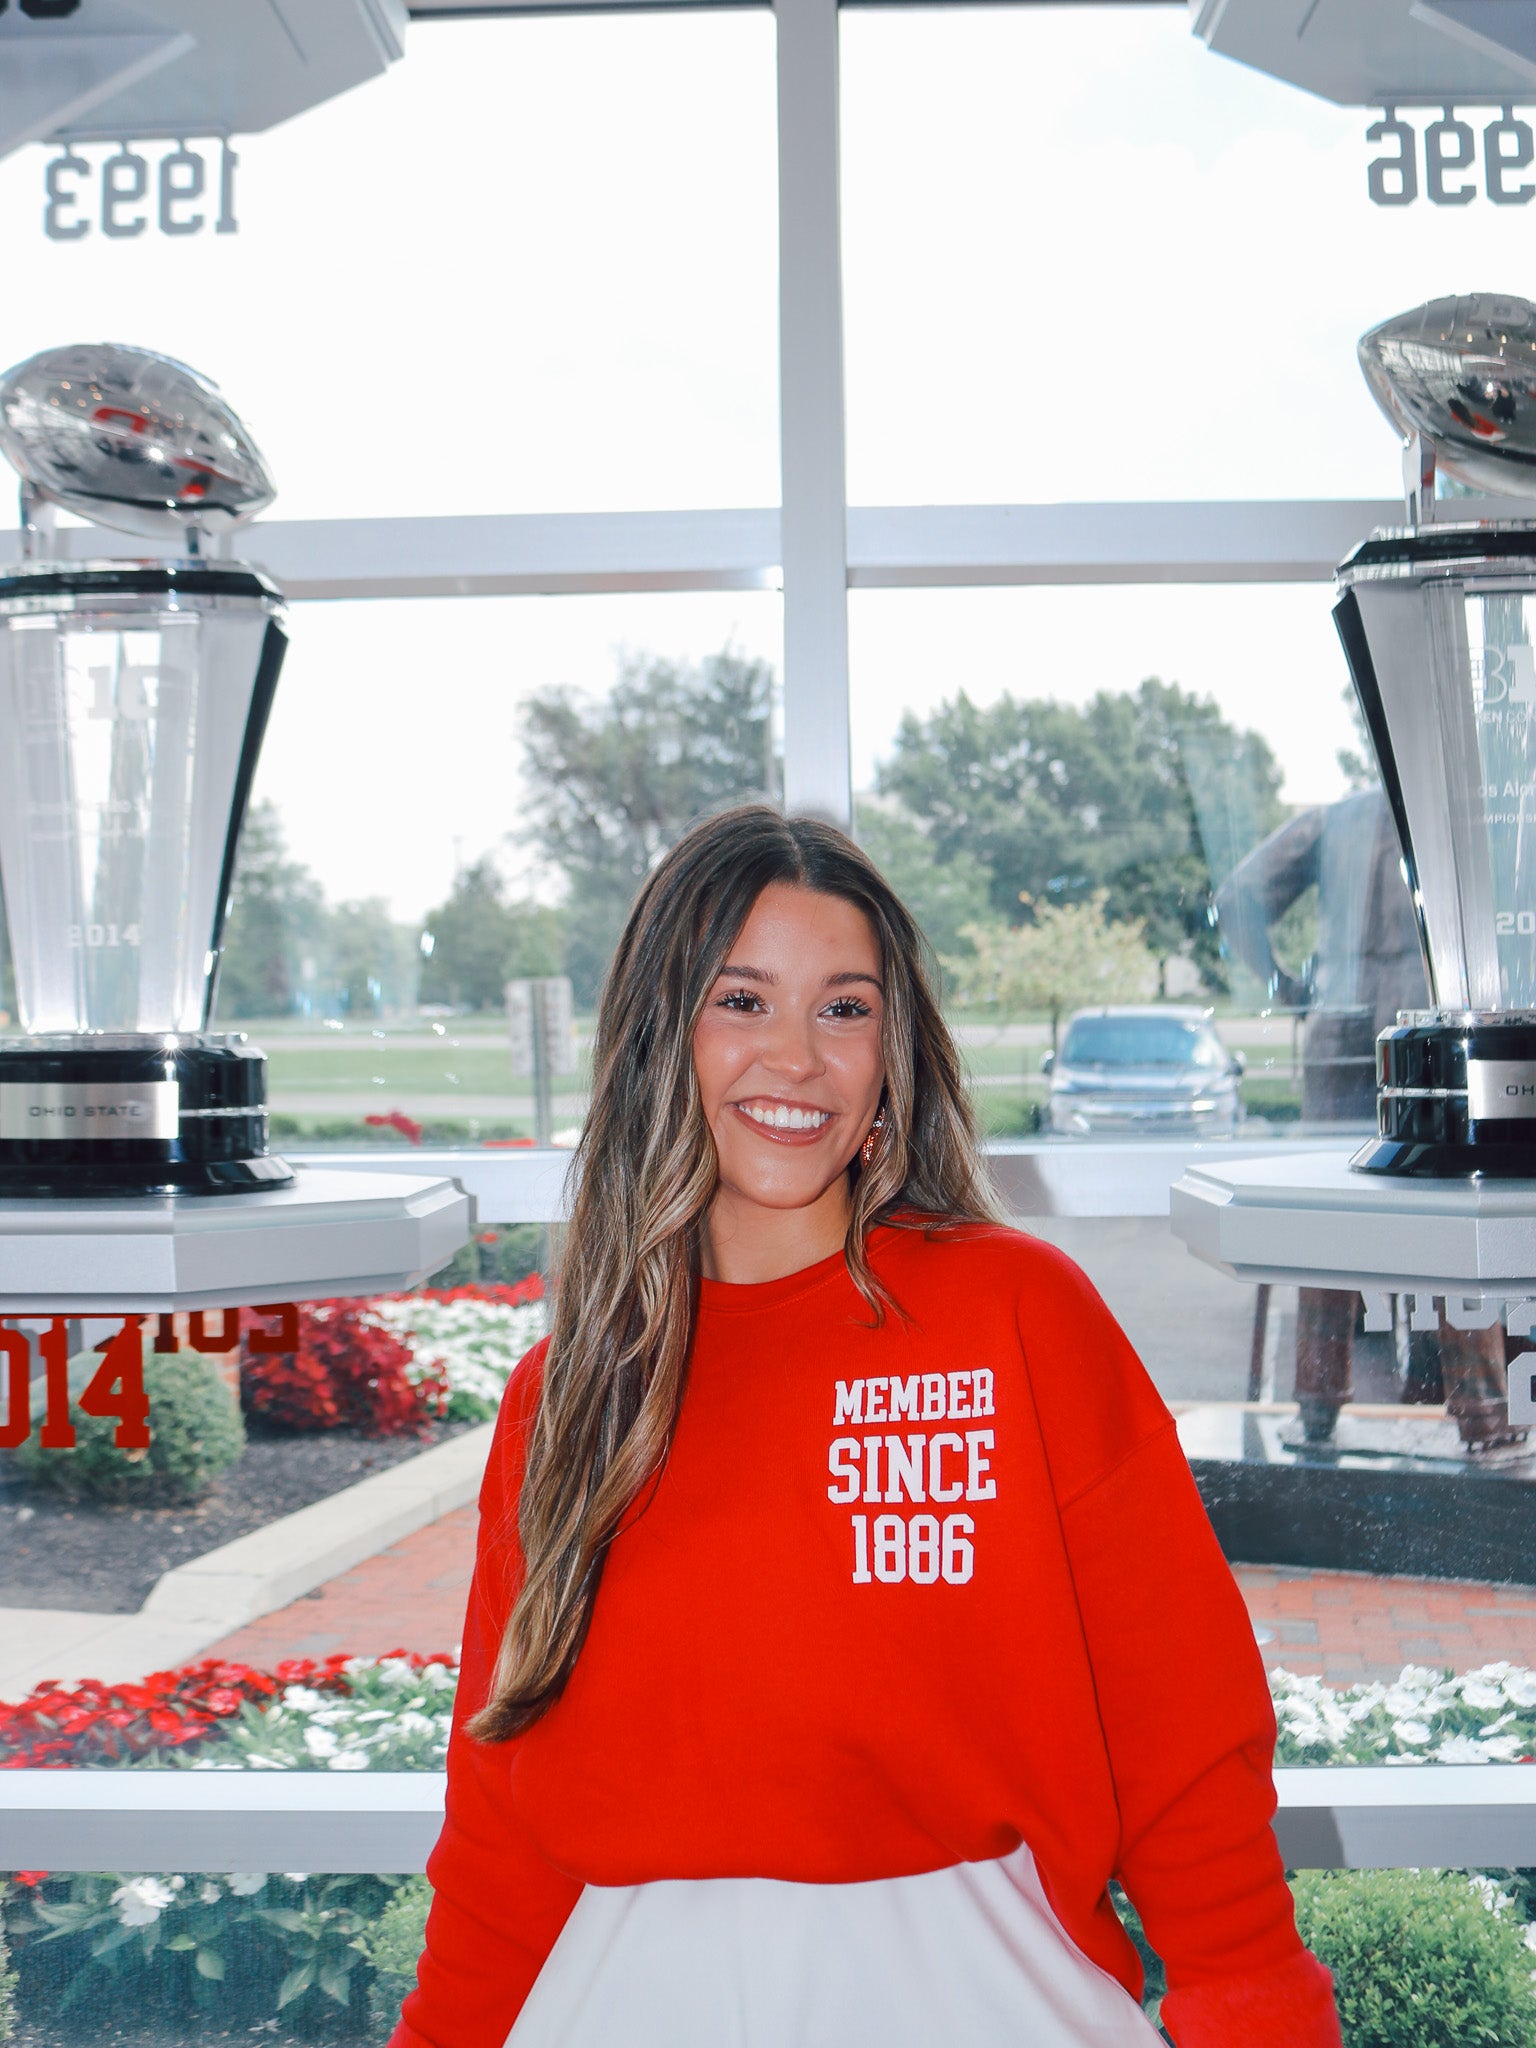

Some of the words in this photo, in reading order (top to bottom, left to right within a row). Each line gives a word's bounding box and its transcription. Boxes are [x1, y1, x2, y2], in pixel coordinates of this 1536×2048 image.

[67, 924, 142, 948] 2014
[29, 1106, 77, 1118] OHIO
[84, 1106, 141, 1118] STATE
[832, 1368, 995, 1426] MEMBER
[827, 1429, 997, 1504] SINCE
[851, 1513, 975, 1584] 1886
